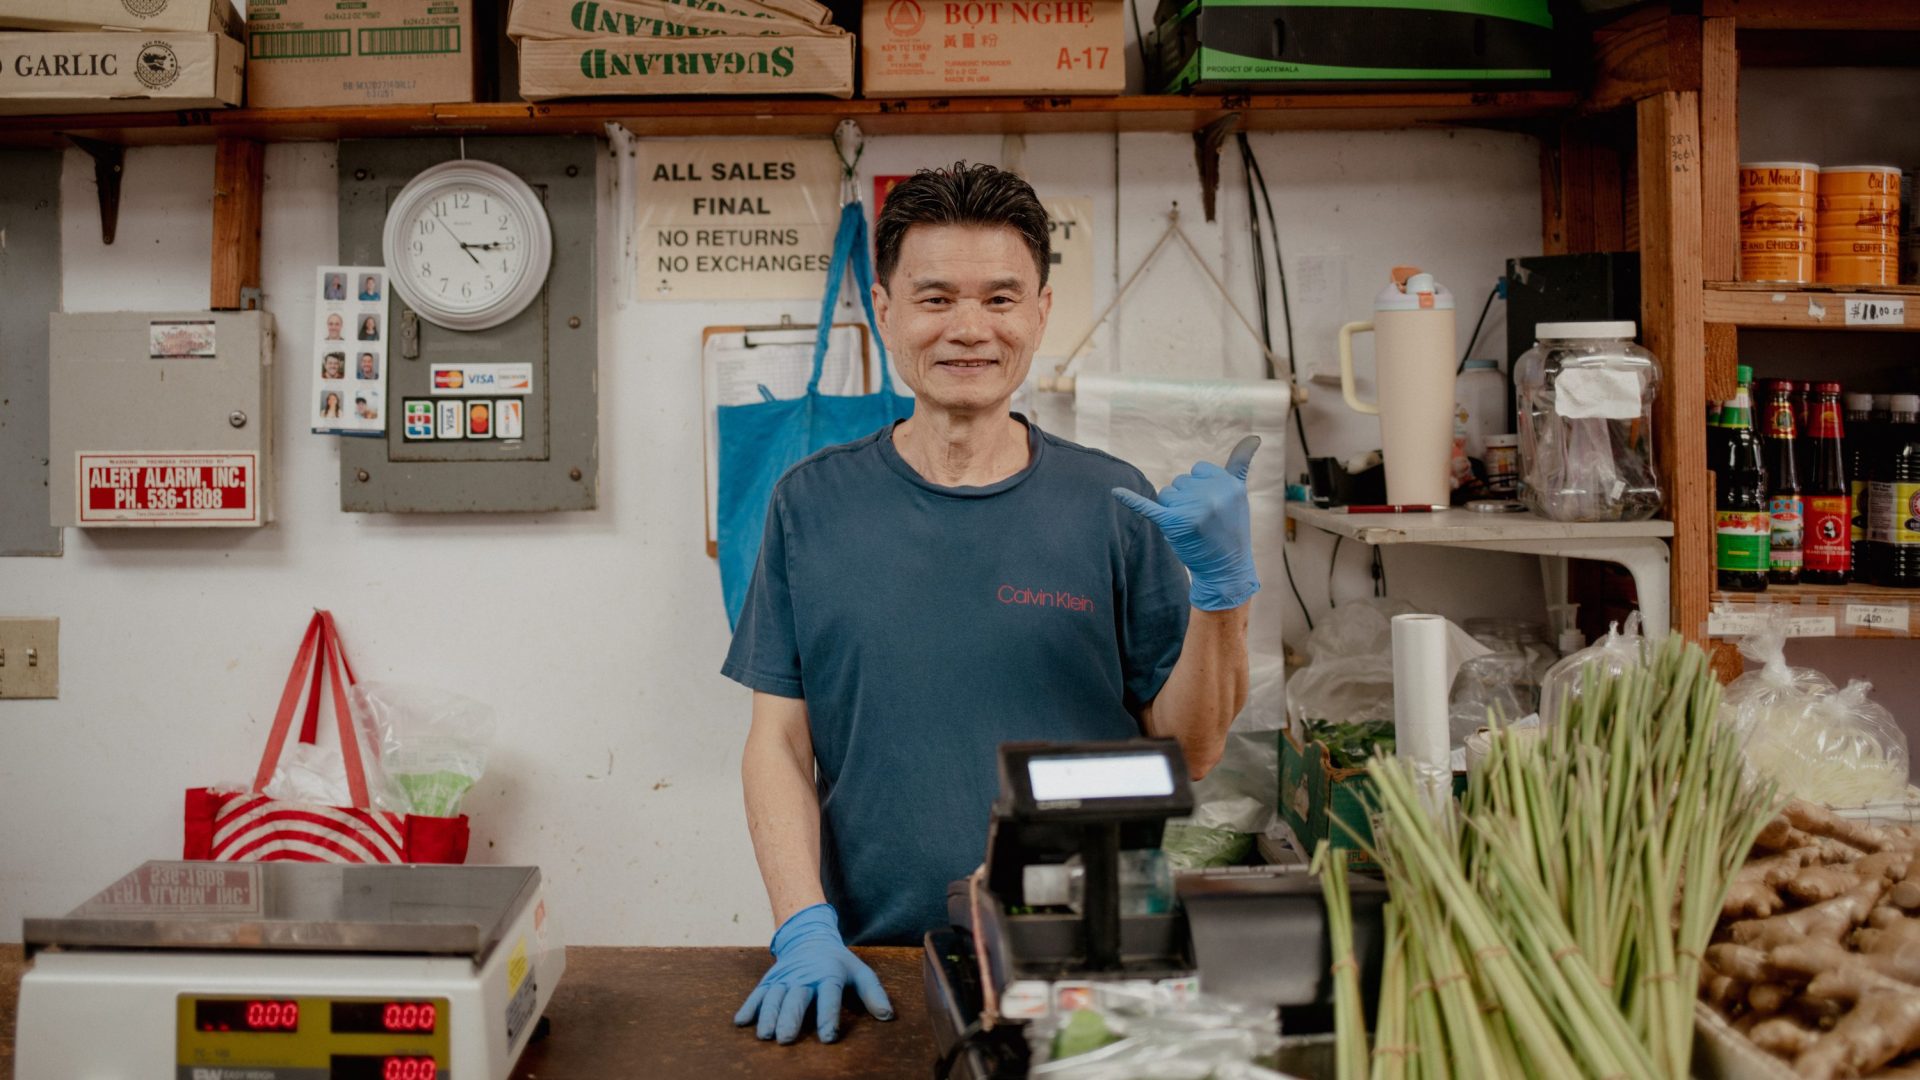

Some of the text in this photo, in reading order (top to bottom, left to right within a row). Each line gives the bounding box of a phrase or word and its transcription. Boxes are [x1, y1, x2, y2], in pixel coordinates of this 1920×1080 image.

[14, 54, 118, 77] GARLIC
[580, 45, 795, 79] SUGARLAND
[1056, 47, 1109, 70] A-17
[652, 162, 796, 181] ALL SALES
[434, 201, 447, 217] 11
[453, 193, 470, 209] 12
[483, 199, 488, 214] 1
[693, 198, 771, 215] FINAL
[420, 219, 434, 235] 10
[499, 216, 508, 230] 2
[658, 229, 799, 247] NO RETURNS
[413, 241, 423, 256] 9
[422, 262, 431, 278] 8
[658, 255, 831, 273] NO EXCHANGES
[440, 278, 449, 293] 7
[461, 282, 472, 298] 6
[484, 275, 494, 291] 5
[468, 374, 494, 384] VISA
[90, 466, 245, 491] ALERT ALARM, INC.
[115, 488, 223, 509] PH. 536-1808
[998, 584, 1094, 612] Calvin Klein
[247, 1002, 298, 1027] 0.00
[384, 1004, 436, 1029] 0.00
[384, 1057, 436, 1080] 0.00
